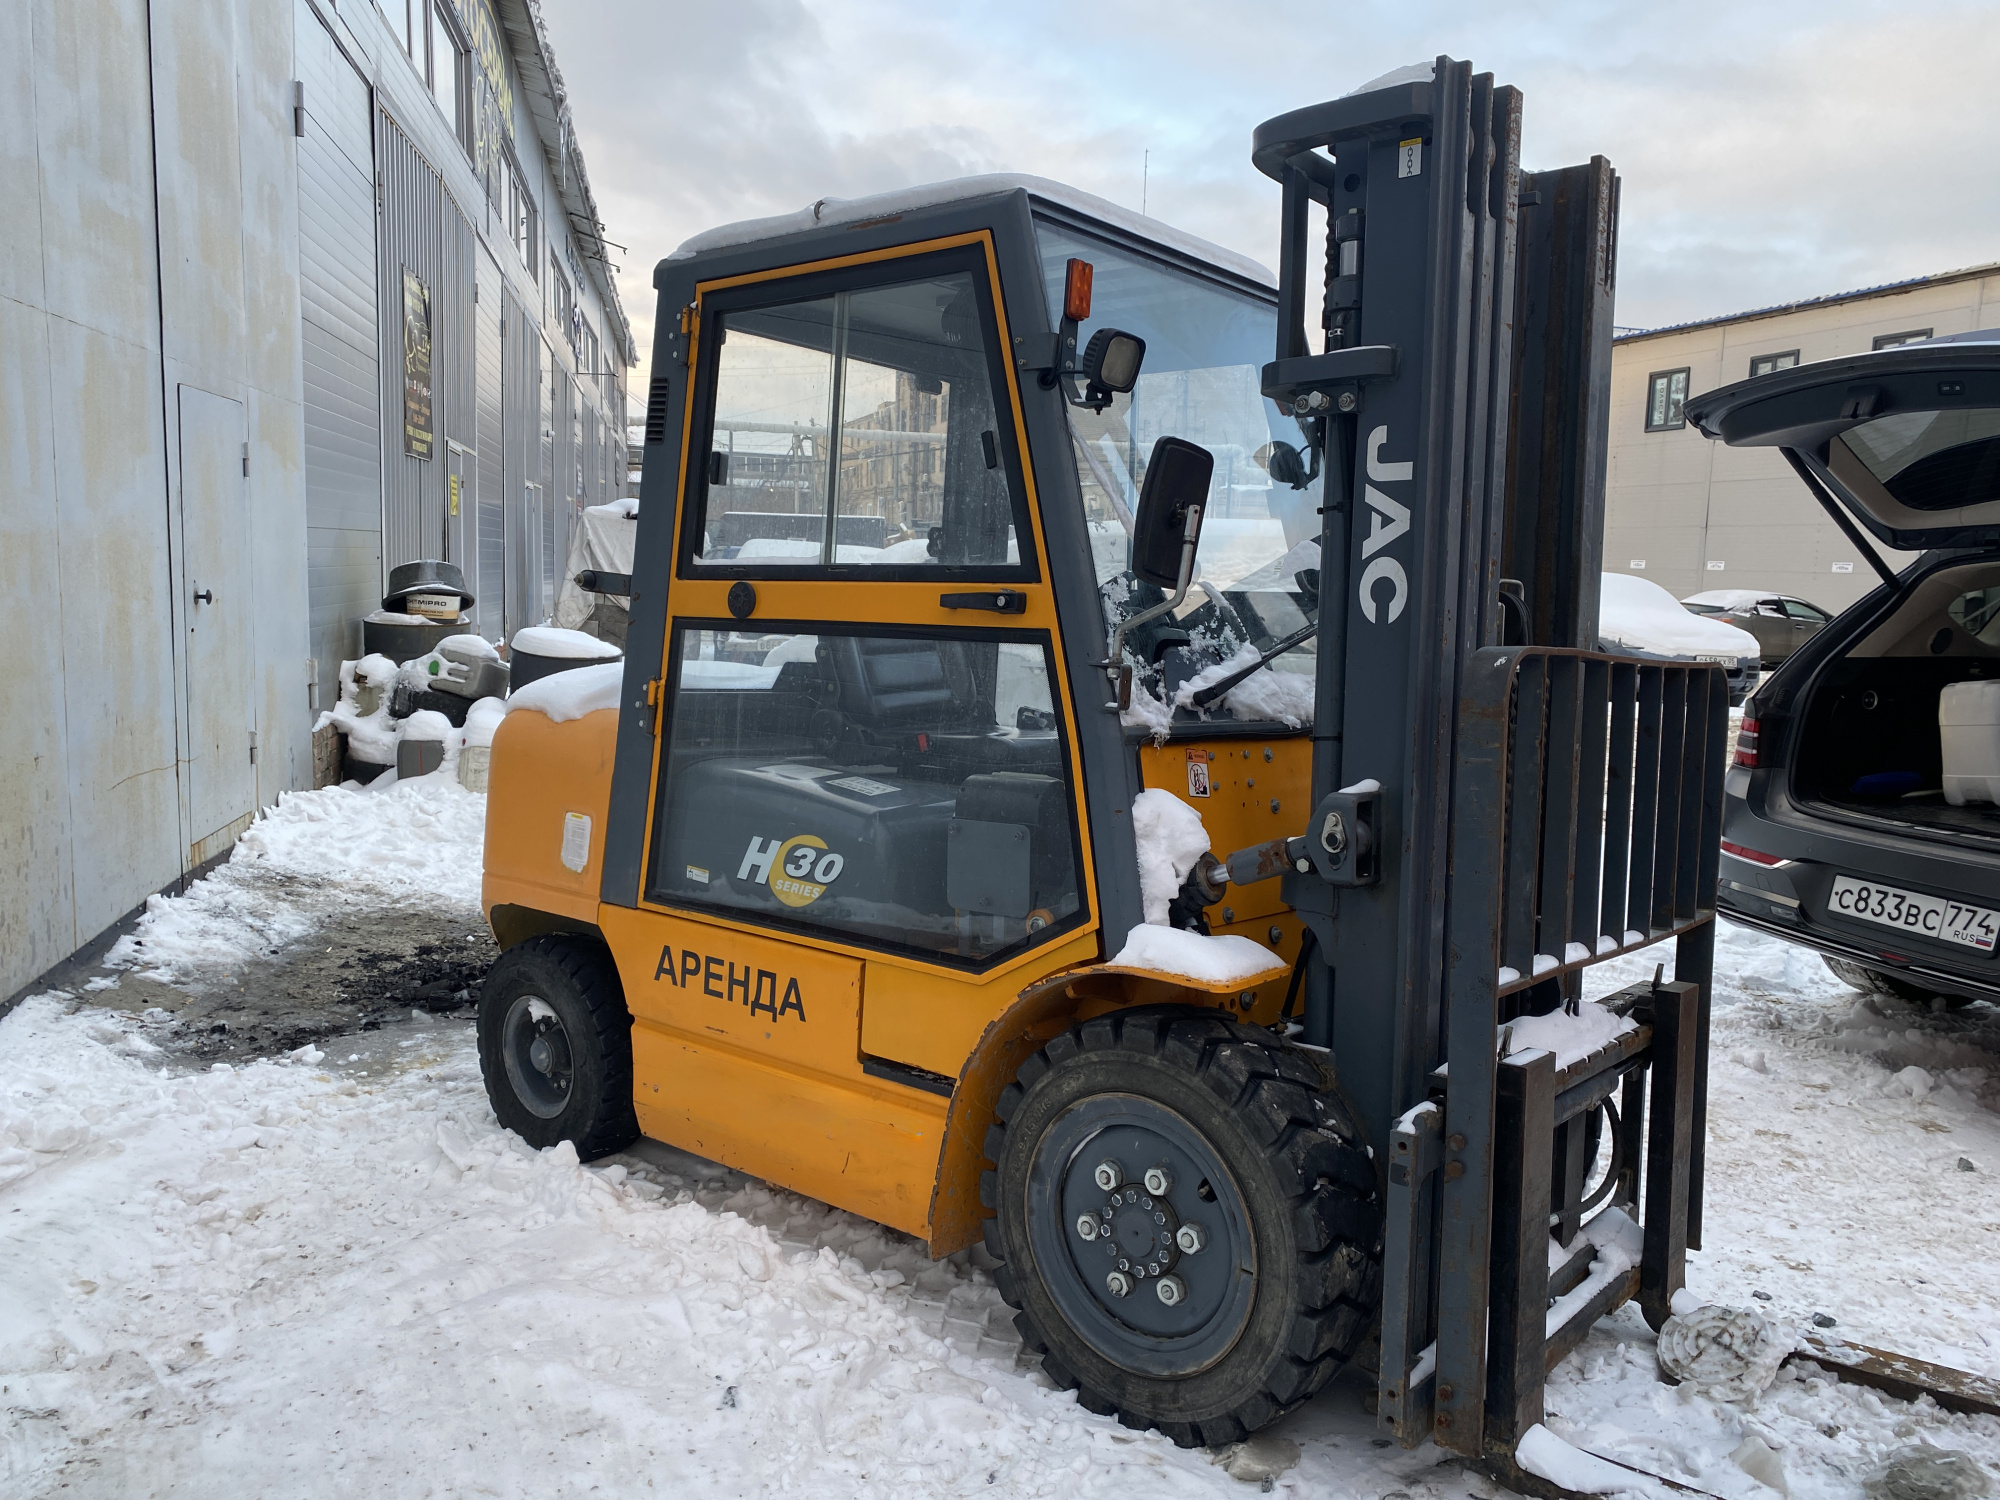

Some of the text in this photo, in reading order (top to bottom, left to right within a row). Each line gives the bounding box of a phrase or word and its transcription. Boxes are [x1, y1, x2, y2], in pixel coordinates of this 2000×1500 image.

[1359, 425, 1413, 624] JAC
[737, 836, 844, 885] H 30
[775, 879, 821, 899] SERIES
[1838, 886, 1992, 936] С833ВС 774
[1953, 930, 1975, 943] RUS
[653, 944, 807, 1023] АРЕНДА
